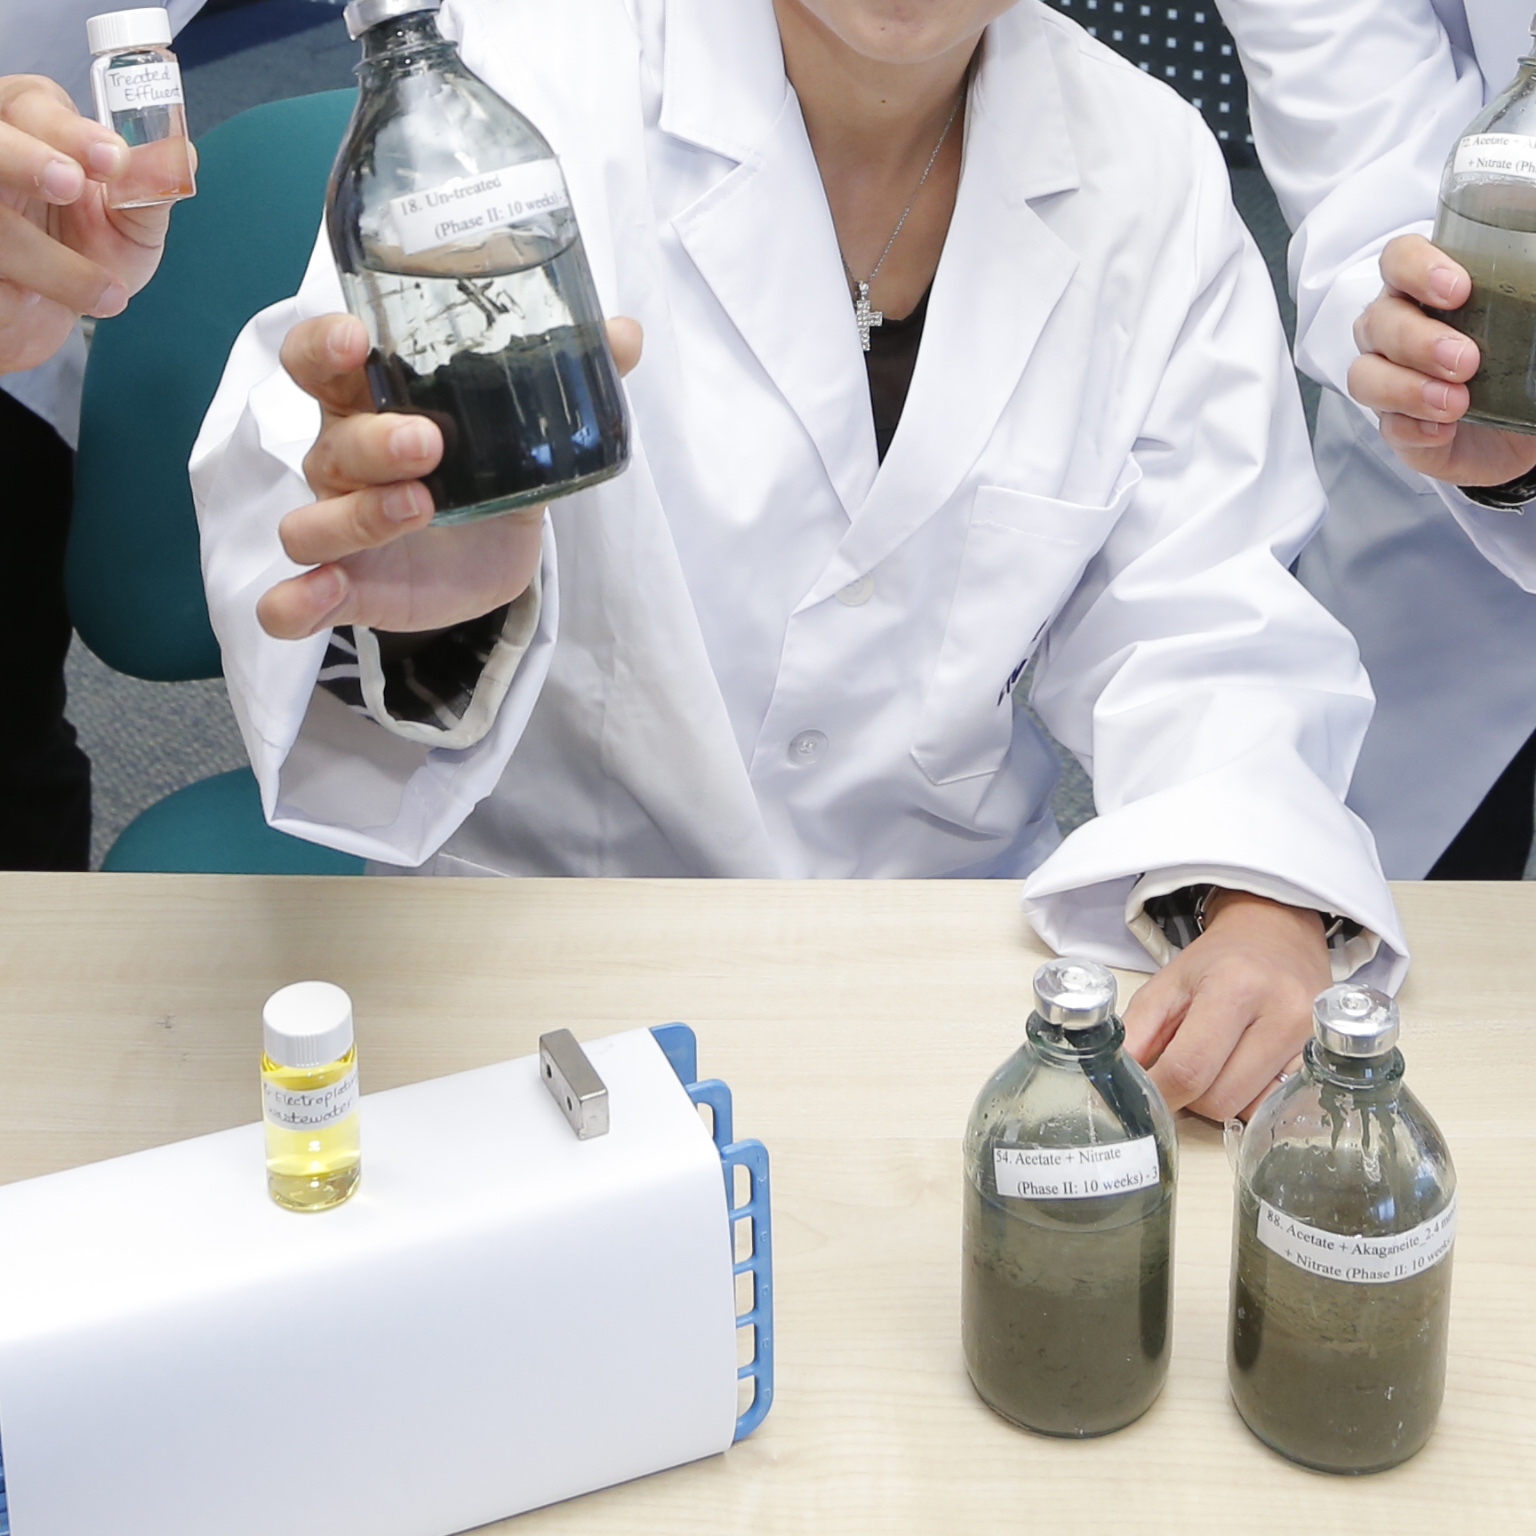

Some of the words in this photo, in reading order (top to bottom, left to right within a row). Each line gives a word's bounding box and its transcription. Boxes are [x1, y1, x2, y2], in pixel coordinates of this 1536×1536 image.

[108, 66, 171, 88] Treated
[124, 84, 182, 102] Effluent
[1472, 136, 1510, 147] Acetate
[1476, 157, 1512, 169] Nitrate
[400, 198, 423, 216] 18.
[425, 176, 502, 208] Un-treated
[435, 216, 484, 240] (Phase
[487, 207, 504, 223] II:
[507, 200, 523, 217] 10
[996, 1150, 1012, 1164] 54.
[1015, 1152, 1061, 1165] Acetate
[1079, 1148, 1121, 1164] Nitrate
[1018, 1181, 1058, 1196] (Phase
[1064, 1182, 1078, 1194] II:
[1084, 1180, 1099, 1193] 10
[1103, 1172, 1143, 1192] weeks)
[1152, 1166, 1158, 1179] 3
[1266, 1209, 1283, 1231] 88.
[1286, 1224, 1335, 1251] Acetate
[1296, 1253, 1342, 1277] Nitrate
[1346, 1267, 1390, 1281] (Phase
[1394, 1264, 1407, 1277] II:
[1412, 1256, 1424, 1271] 10
